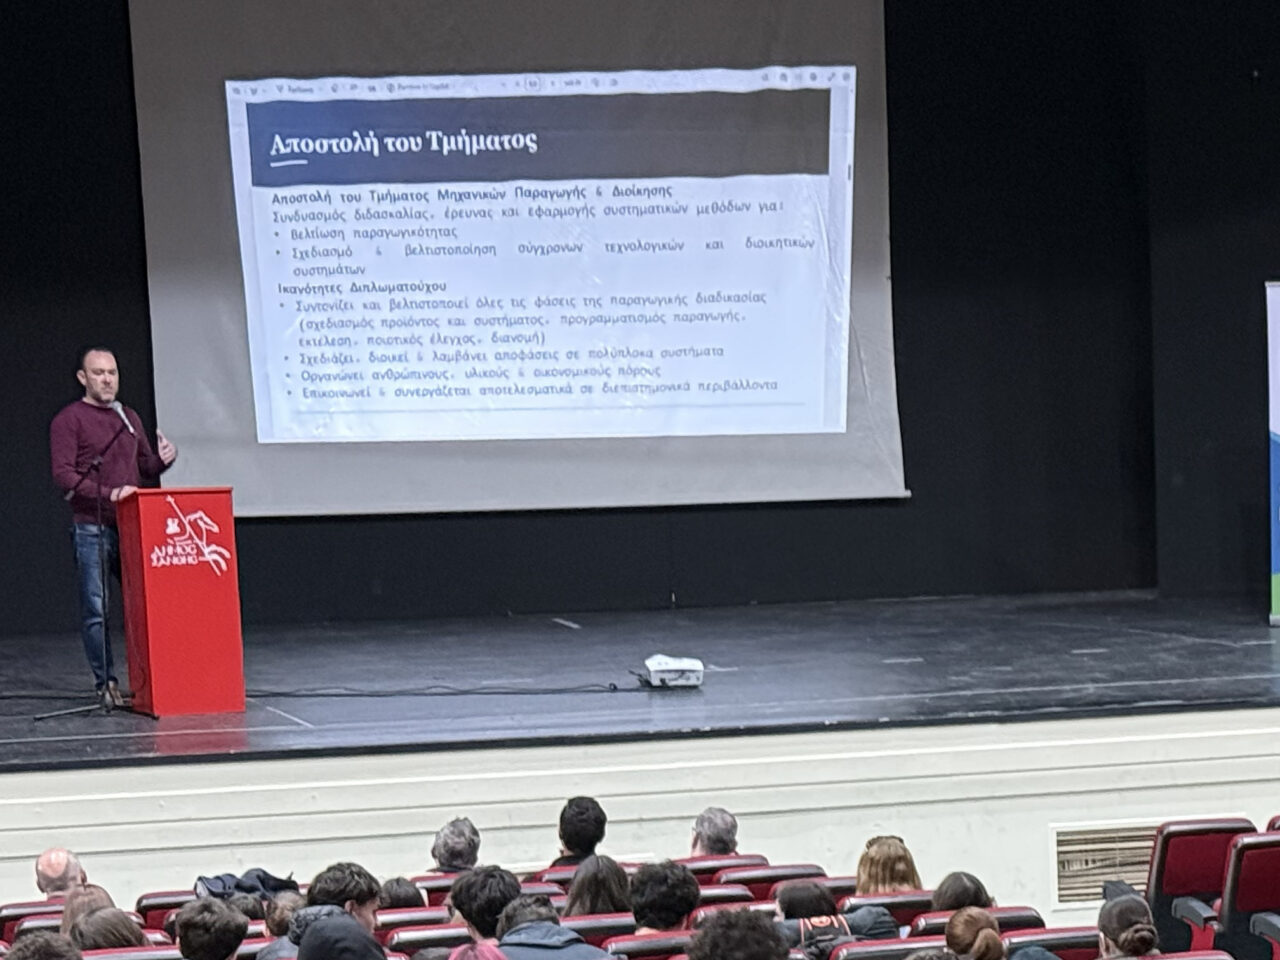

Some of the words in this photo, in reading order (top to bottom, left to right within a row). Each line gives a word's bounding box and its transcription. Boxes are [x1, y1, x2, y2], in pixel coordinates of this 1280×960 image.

[270, 130, 379, 157] Αποστολή
[384, 137, 421, 153] του
[426, 129, 538, 156] Τμήματος
[272, 190, 332, 205] Αποστολή
[340, 193, 361, 204] του
[369, 189, 430, 205] Τμήματος
[437, 187, 506, 204] Μηχανικών
[515, 186, 586, 201] Παραγωγής
[612, 185, 672, 199] Διοίκησης
[273, 209, 346, 223] Συνδυασμός
[444, 206, 493, 219] έρευνας
[502, 207, 519, 217] και
[528, 203, 595, 219] εφαρμογής
[604, 200, 688, 217] συστηματικών
[696, 199, 751, 216] μεθόδων
[353, 226, 458, 241] παραγωγικότητας
[292, 245, 353, 261] Σχεδιασμό
[405, 242, 496, 258] βελτιστοποίηση
[518, 241, 583, 256] σύγχρονων
[605, 239, 684, 255] τεχνολογικών
[705, 240, 724, 250] και
[745, 235, 815, 250] διοικητικών
[293, 262, 366, 277] συστημάτων
[278, 282, 342, 296] Ικανότητες
[350, 280, 447, 294] Διπλωματούχου
[363, 300, 381, 311] και
[476, 296, 504, 309] όλες
[511, 297, 526, 309] τις
[534, 295, 576, 309] φάσεις
[583, 297, 602, 308] της
[610, 293, 688, 307] παραγωγικής
[695, 290, 767, 304] διαδικασίας
[447, 318, 466, 327] και
[560, 312, 666, 325] προγραμματισμός
[566, 351, 580, 360] σε
[580, 385, 593, 394] σε
